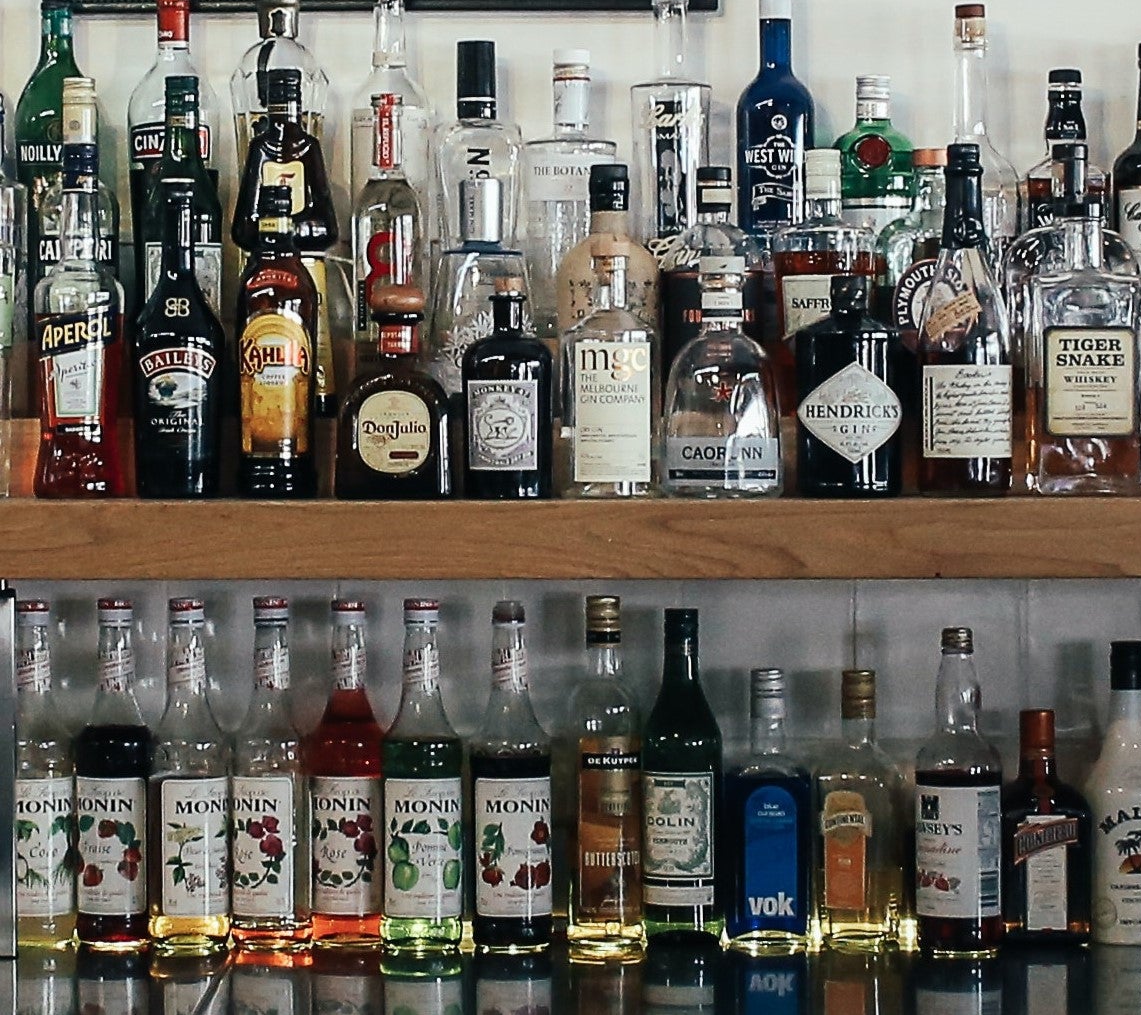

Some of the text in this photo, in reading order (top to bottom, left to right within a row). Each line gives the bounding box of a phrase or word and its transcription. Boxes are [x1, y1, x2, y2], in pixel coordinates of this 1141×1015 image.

[20, 144, 63, 163] NOILLY
[744, 148, 773, 164] WEST
[897, 263, 940, 326] PLYMOUTH
[42, 316, 112, 352] APEROL
[1058, 337, 1122, 353] TIGER
[144, 348, 214, 375] BAILEYS
[240, 337, 309, 377] KAHLA
[580, 346, 648, 382] mgc
[1055, 352, 1126, 368] SNAKE
[580, 373, 598, 383] THE
[1063, 374, 1117, 385] WHISKEY
[580, 385, 639, 395] MELBOURNE
[805, 403, 899, 420] HENDRICK'S
[838, 424, 871, 435] GIN
[681, 445, 763, 461] CAORNN
[394, 797, 461, 814] MONIN
[485, 797, 551, 815] MONIN
[320, 844, 347, 863] Rose
[748, 891, 795, 917] vok
